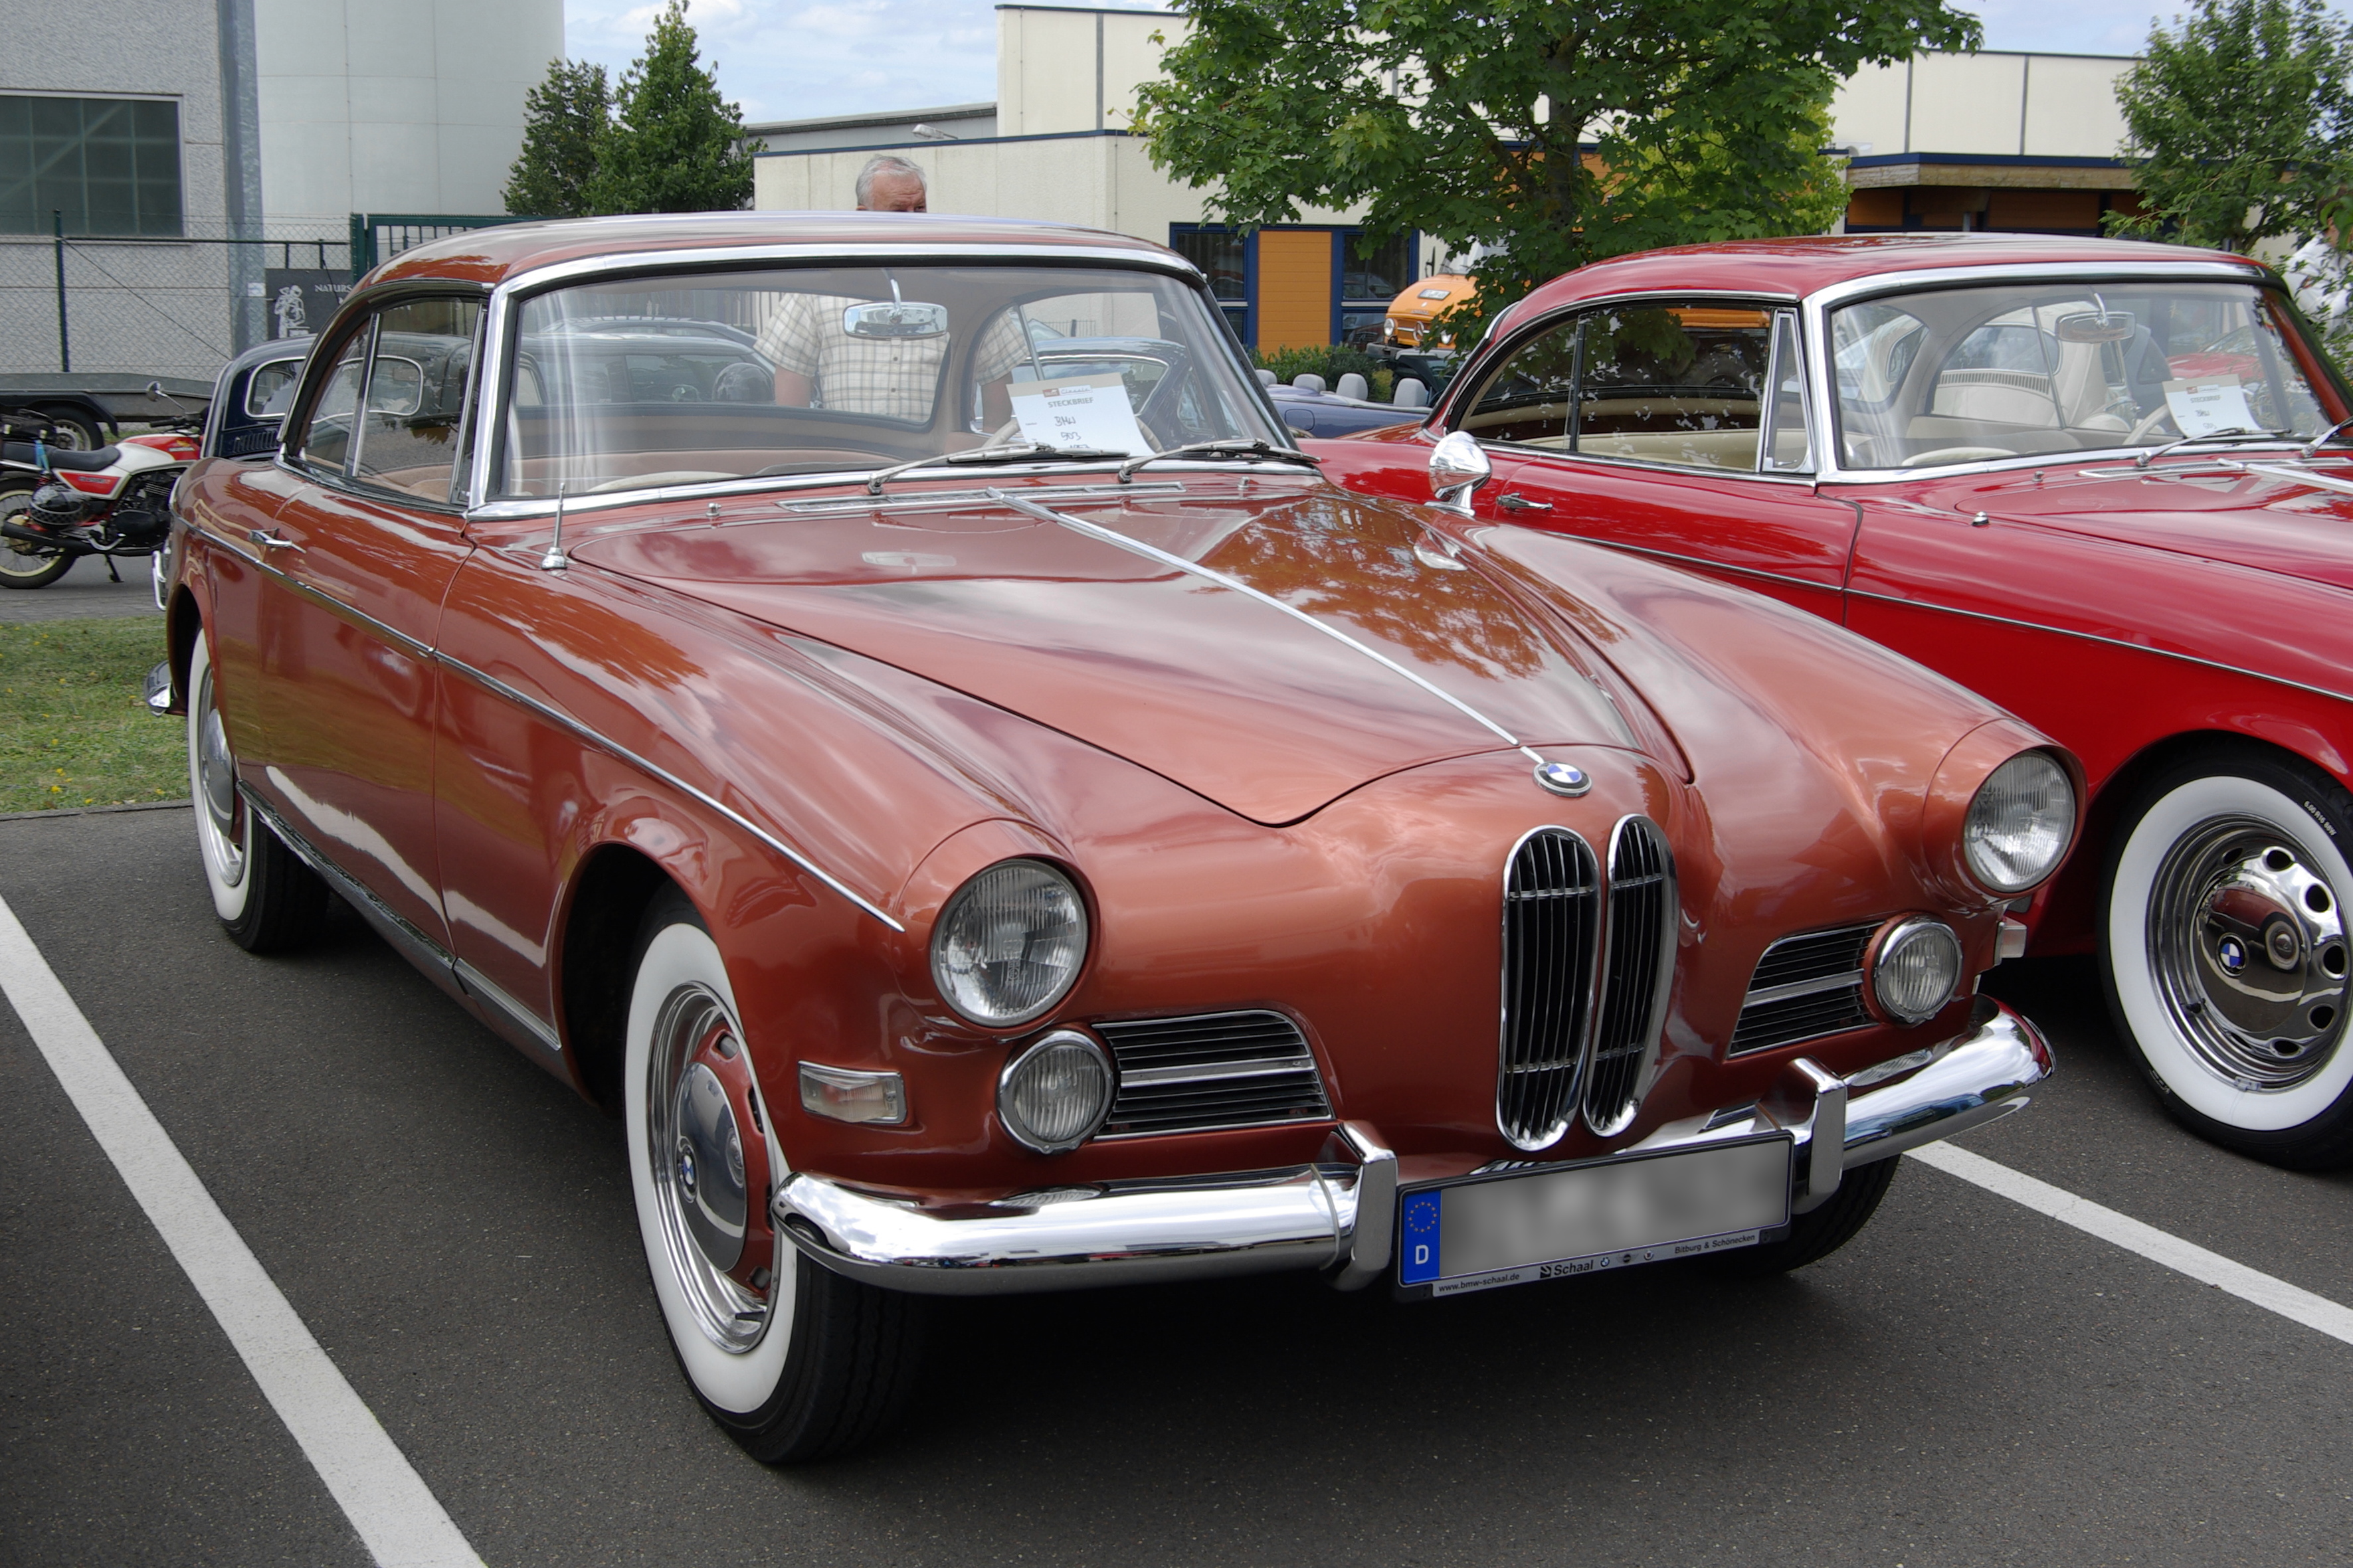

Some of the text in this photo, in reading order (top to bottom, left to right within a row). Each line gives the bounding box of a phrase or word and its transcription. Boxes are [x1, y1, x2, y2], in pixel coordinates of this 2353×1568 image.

[1048, 397, 1094, 408] STECKBRIEF
[1054, 416, 1076, 426] BMW
[1061, 432, 1082, 441] 503
[2304, 800, 2316, 814] 6.00
[2314, 810, 2326, 824] R16
[1674, 1245, 1702, 1254] Bitburg
[1712, 1235, 1755, 1247] Schönecken
[1415, 1245, 1429, 1264] D
[1554, 1260, 1594, 1276] Schaal
[1438, 1273, 1520, 1292] www.bmw-schaal.de
